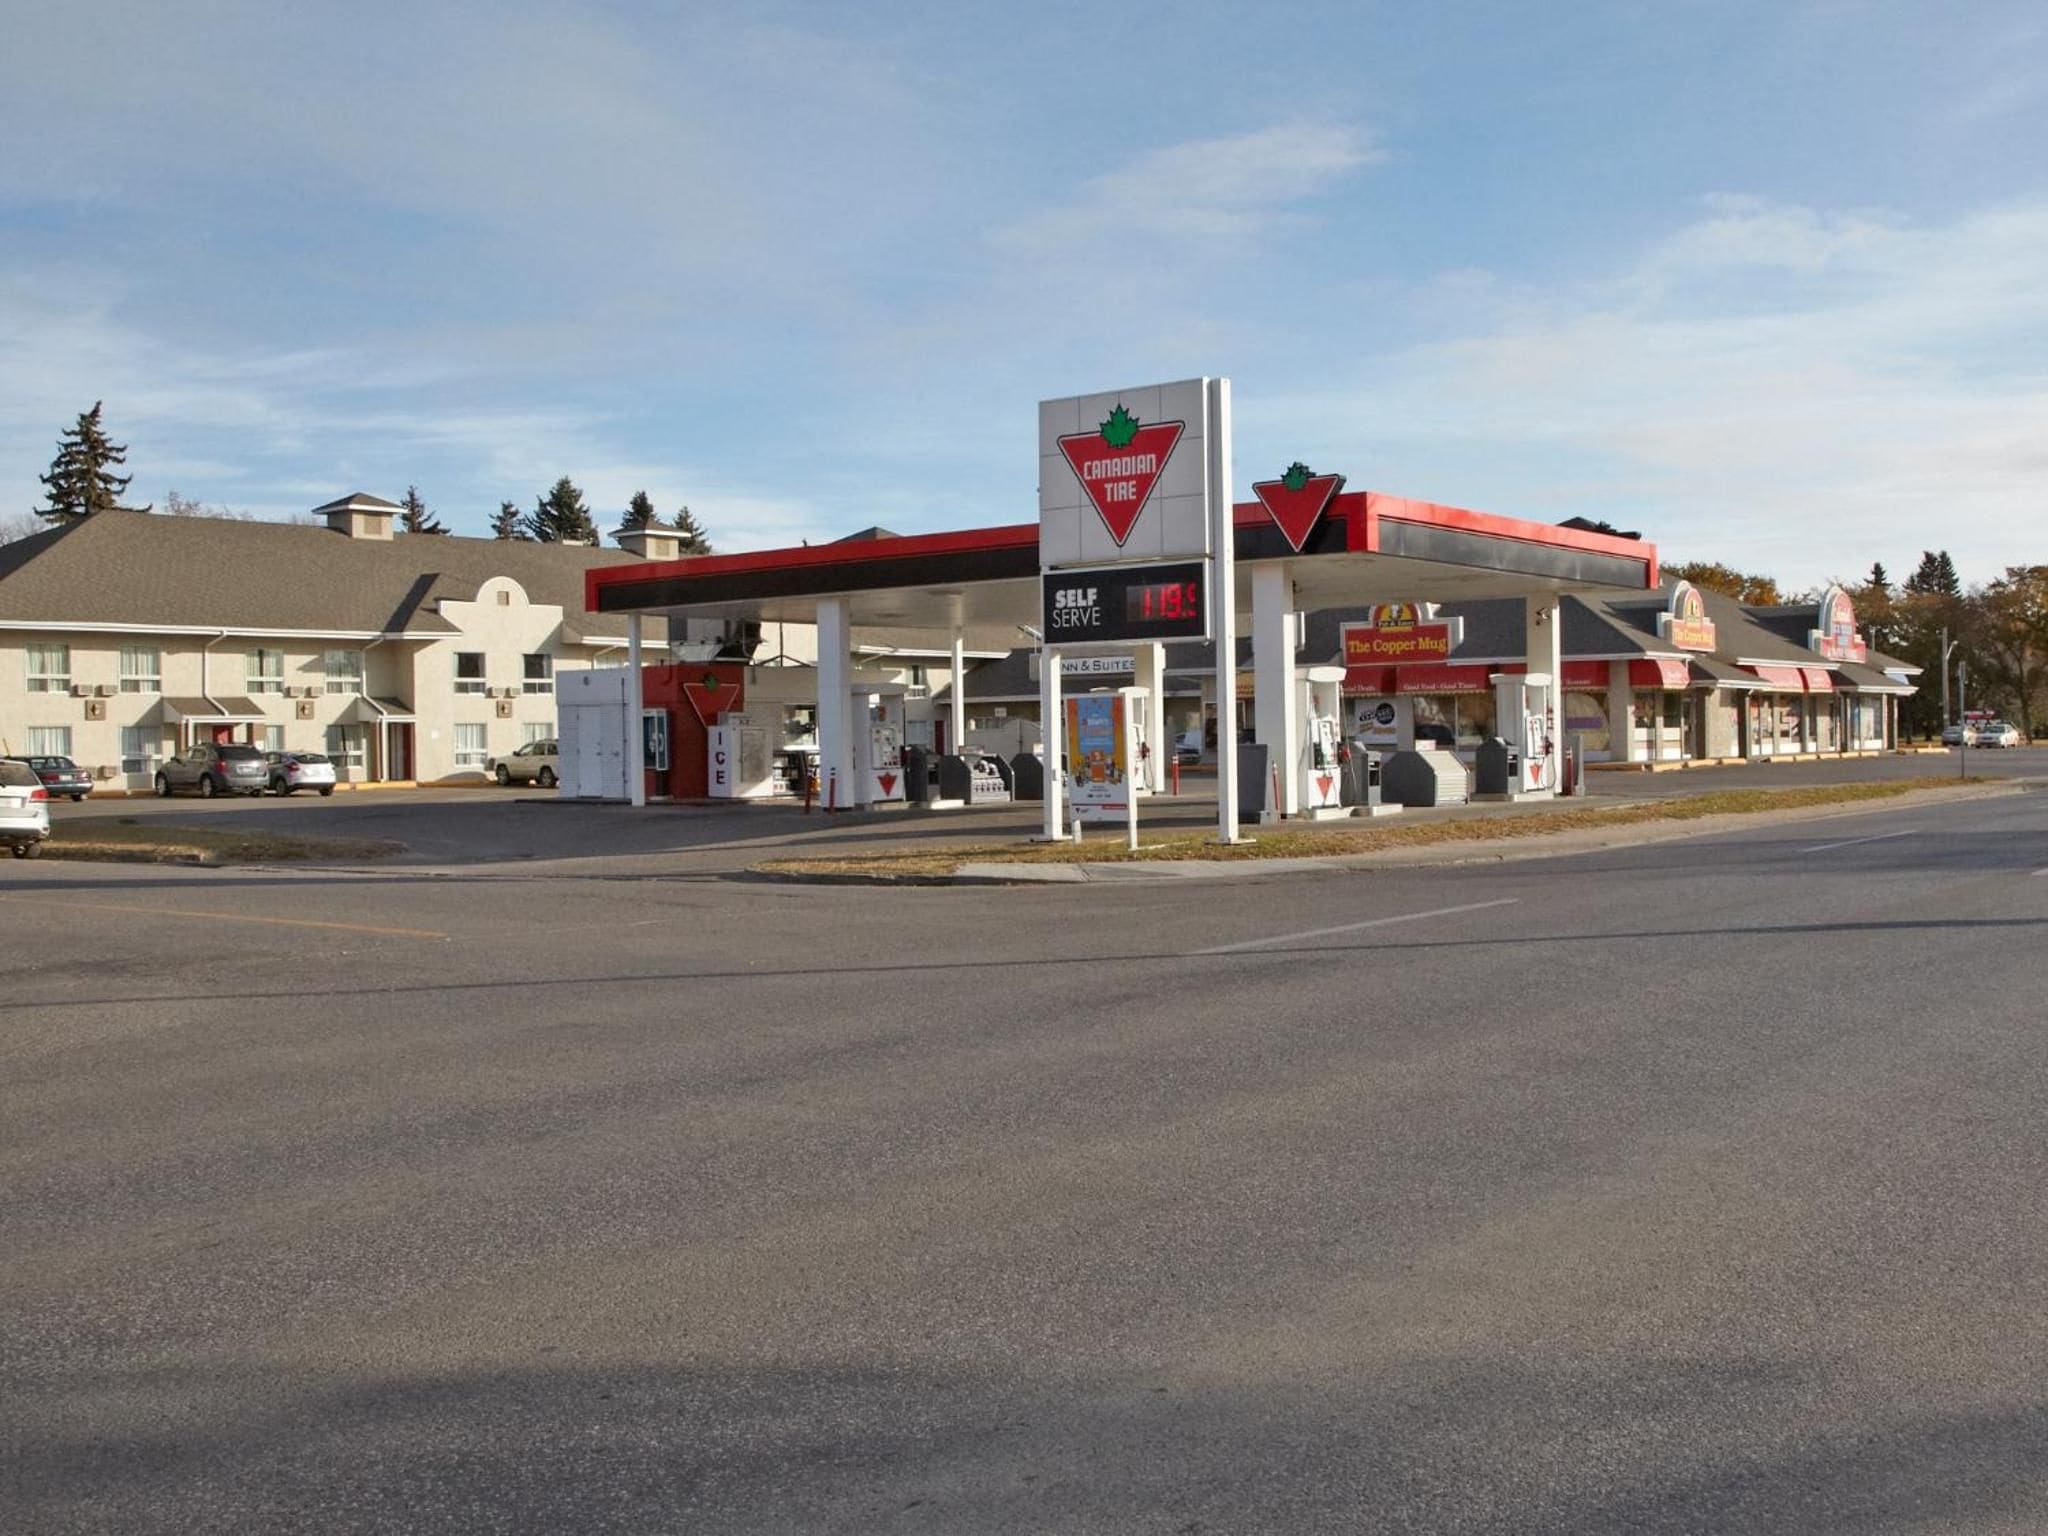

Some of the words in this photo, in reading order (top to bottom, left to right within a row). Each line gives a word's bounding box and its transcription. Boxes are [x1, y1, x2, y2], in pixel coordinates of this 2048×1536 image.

[1083, 453, 1156, 480] CANADIAN
[1104, 480, 1137, 502] TIRE
[1054, 587, 1098, 609] SELF
[1052, 606, 1101, 629] SERVE
[1349, 640, 1371, 653] The
[1373, 638, 1416, 655] Copper
[1417, 637, 1447, 653] Mug
[1061, 663, 1078, 672] NN
[1081, 660, 1090, 671] &
[715, 731, 726, 785] ICE
